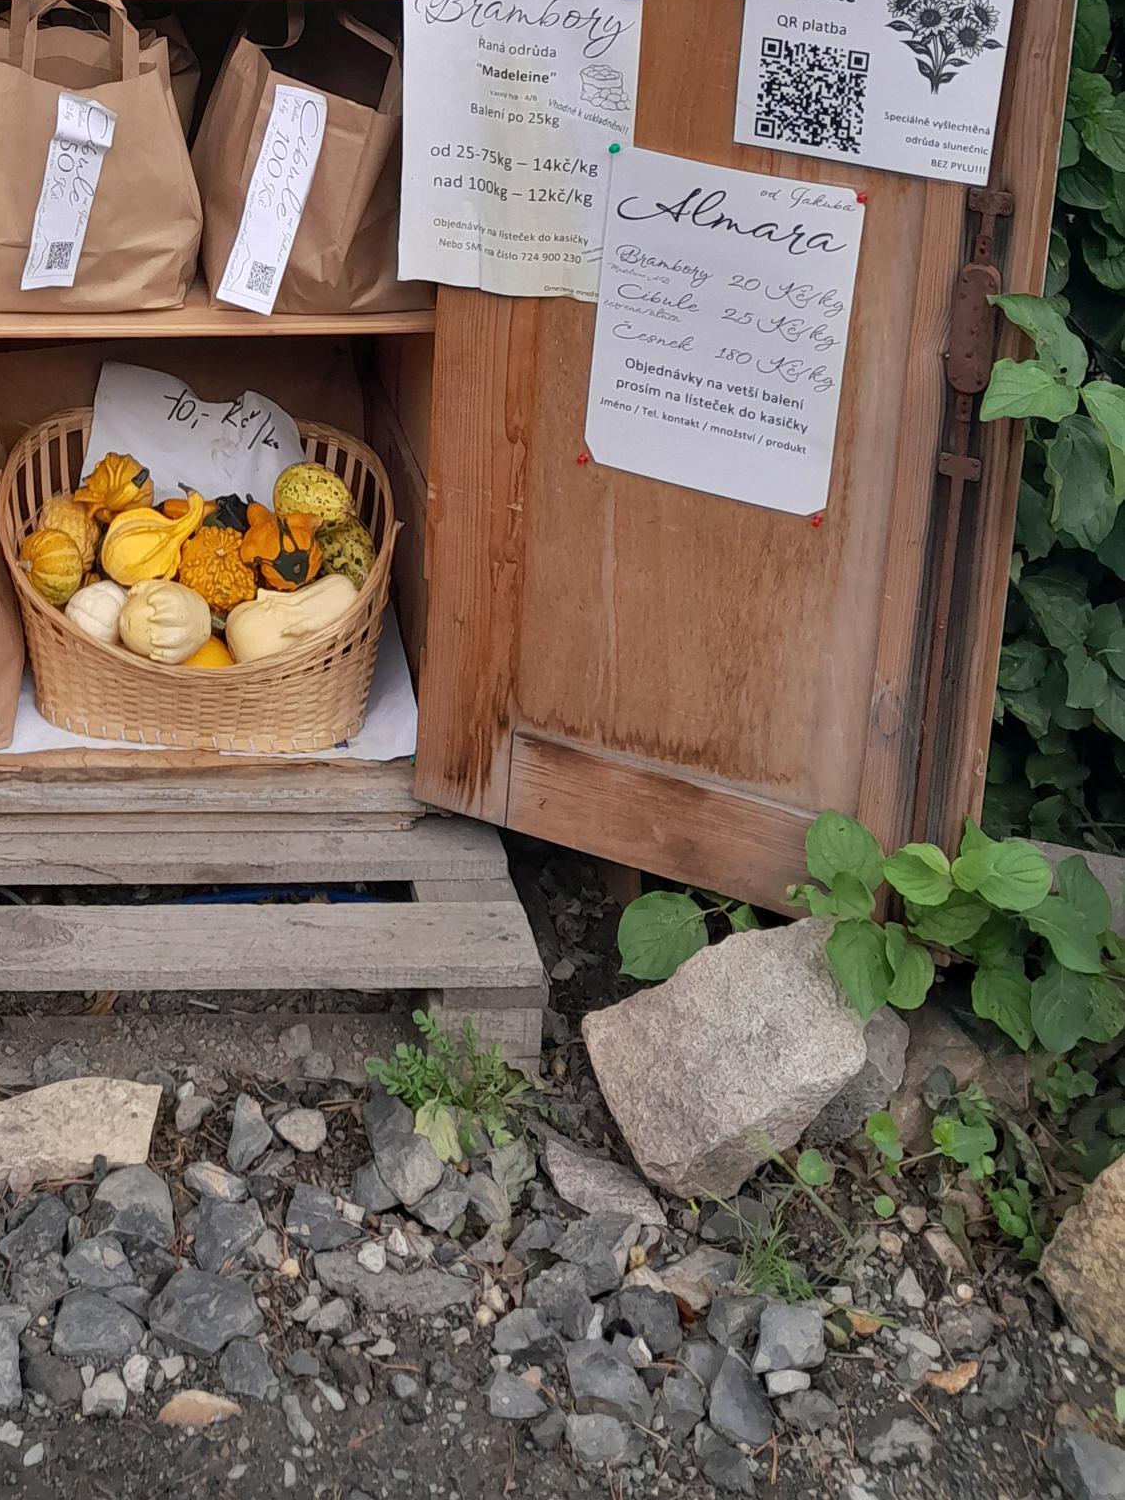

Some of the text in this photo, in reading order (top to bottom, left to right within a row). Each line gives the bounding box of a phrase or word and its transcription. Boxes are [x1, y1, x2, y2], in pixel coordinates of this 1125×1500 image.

[776, 14, 848, 36] QR platba
[477, 36, 558, 59] Raná odrůda
[470, 102, 561, 129] Balení po 25kg
[883, 110, 991, 136] Speciálně vyšlechtěná
[56, 139, 78, 173] 50
[68, 106, 109, 206] Cibule
[265, 130, 291, 179] 100
[275, 99, 319, 222] Cibule
[429, 143, 599, 178] od 25-75kg 14kč/kg
[905, 135, 989, 156] odrůda slunečnic
[930, 158, 987, 176] BEZ PYLU!!!
[432, 174, 594, 208] nad 100kg 12kč/kg
[760, 187, 856, 213] od Jakuba
[487, 228, 497, 237] na
[498, 230, 536, 243] lísteček
[537, 233, 552, 243] do
[553, 232, 589, 247] kasičky
[617, 187, 847, 255] Almara
[438, 238, 463, 250] Nebo
[484, 247, 495, 257] na
[496, 249, 519, 261] číslo
[521, 251, 540, 263] 724
[542, 253, 562, 263] 900
[563, 253, 582, 265] 230
[615, 244, 714, 288] Brambory
[727, 274, 762, 291] 20
[617, 283, 700, 312] Cibule
[721, 308, 755, 325] 25
[612, 320, 695, 352] Česnek
[714, 347, 753, 365] 180
[624, 357, 704, 388] Objednávky
[706, 379, 724, 391] na
[762, 390, 806, 411] balení
[615, 378, 809, 435] prosím na lísteček do kasičky
[599, 396, 807, 455] Jméno Tel. kontakt množství produkt
